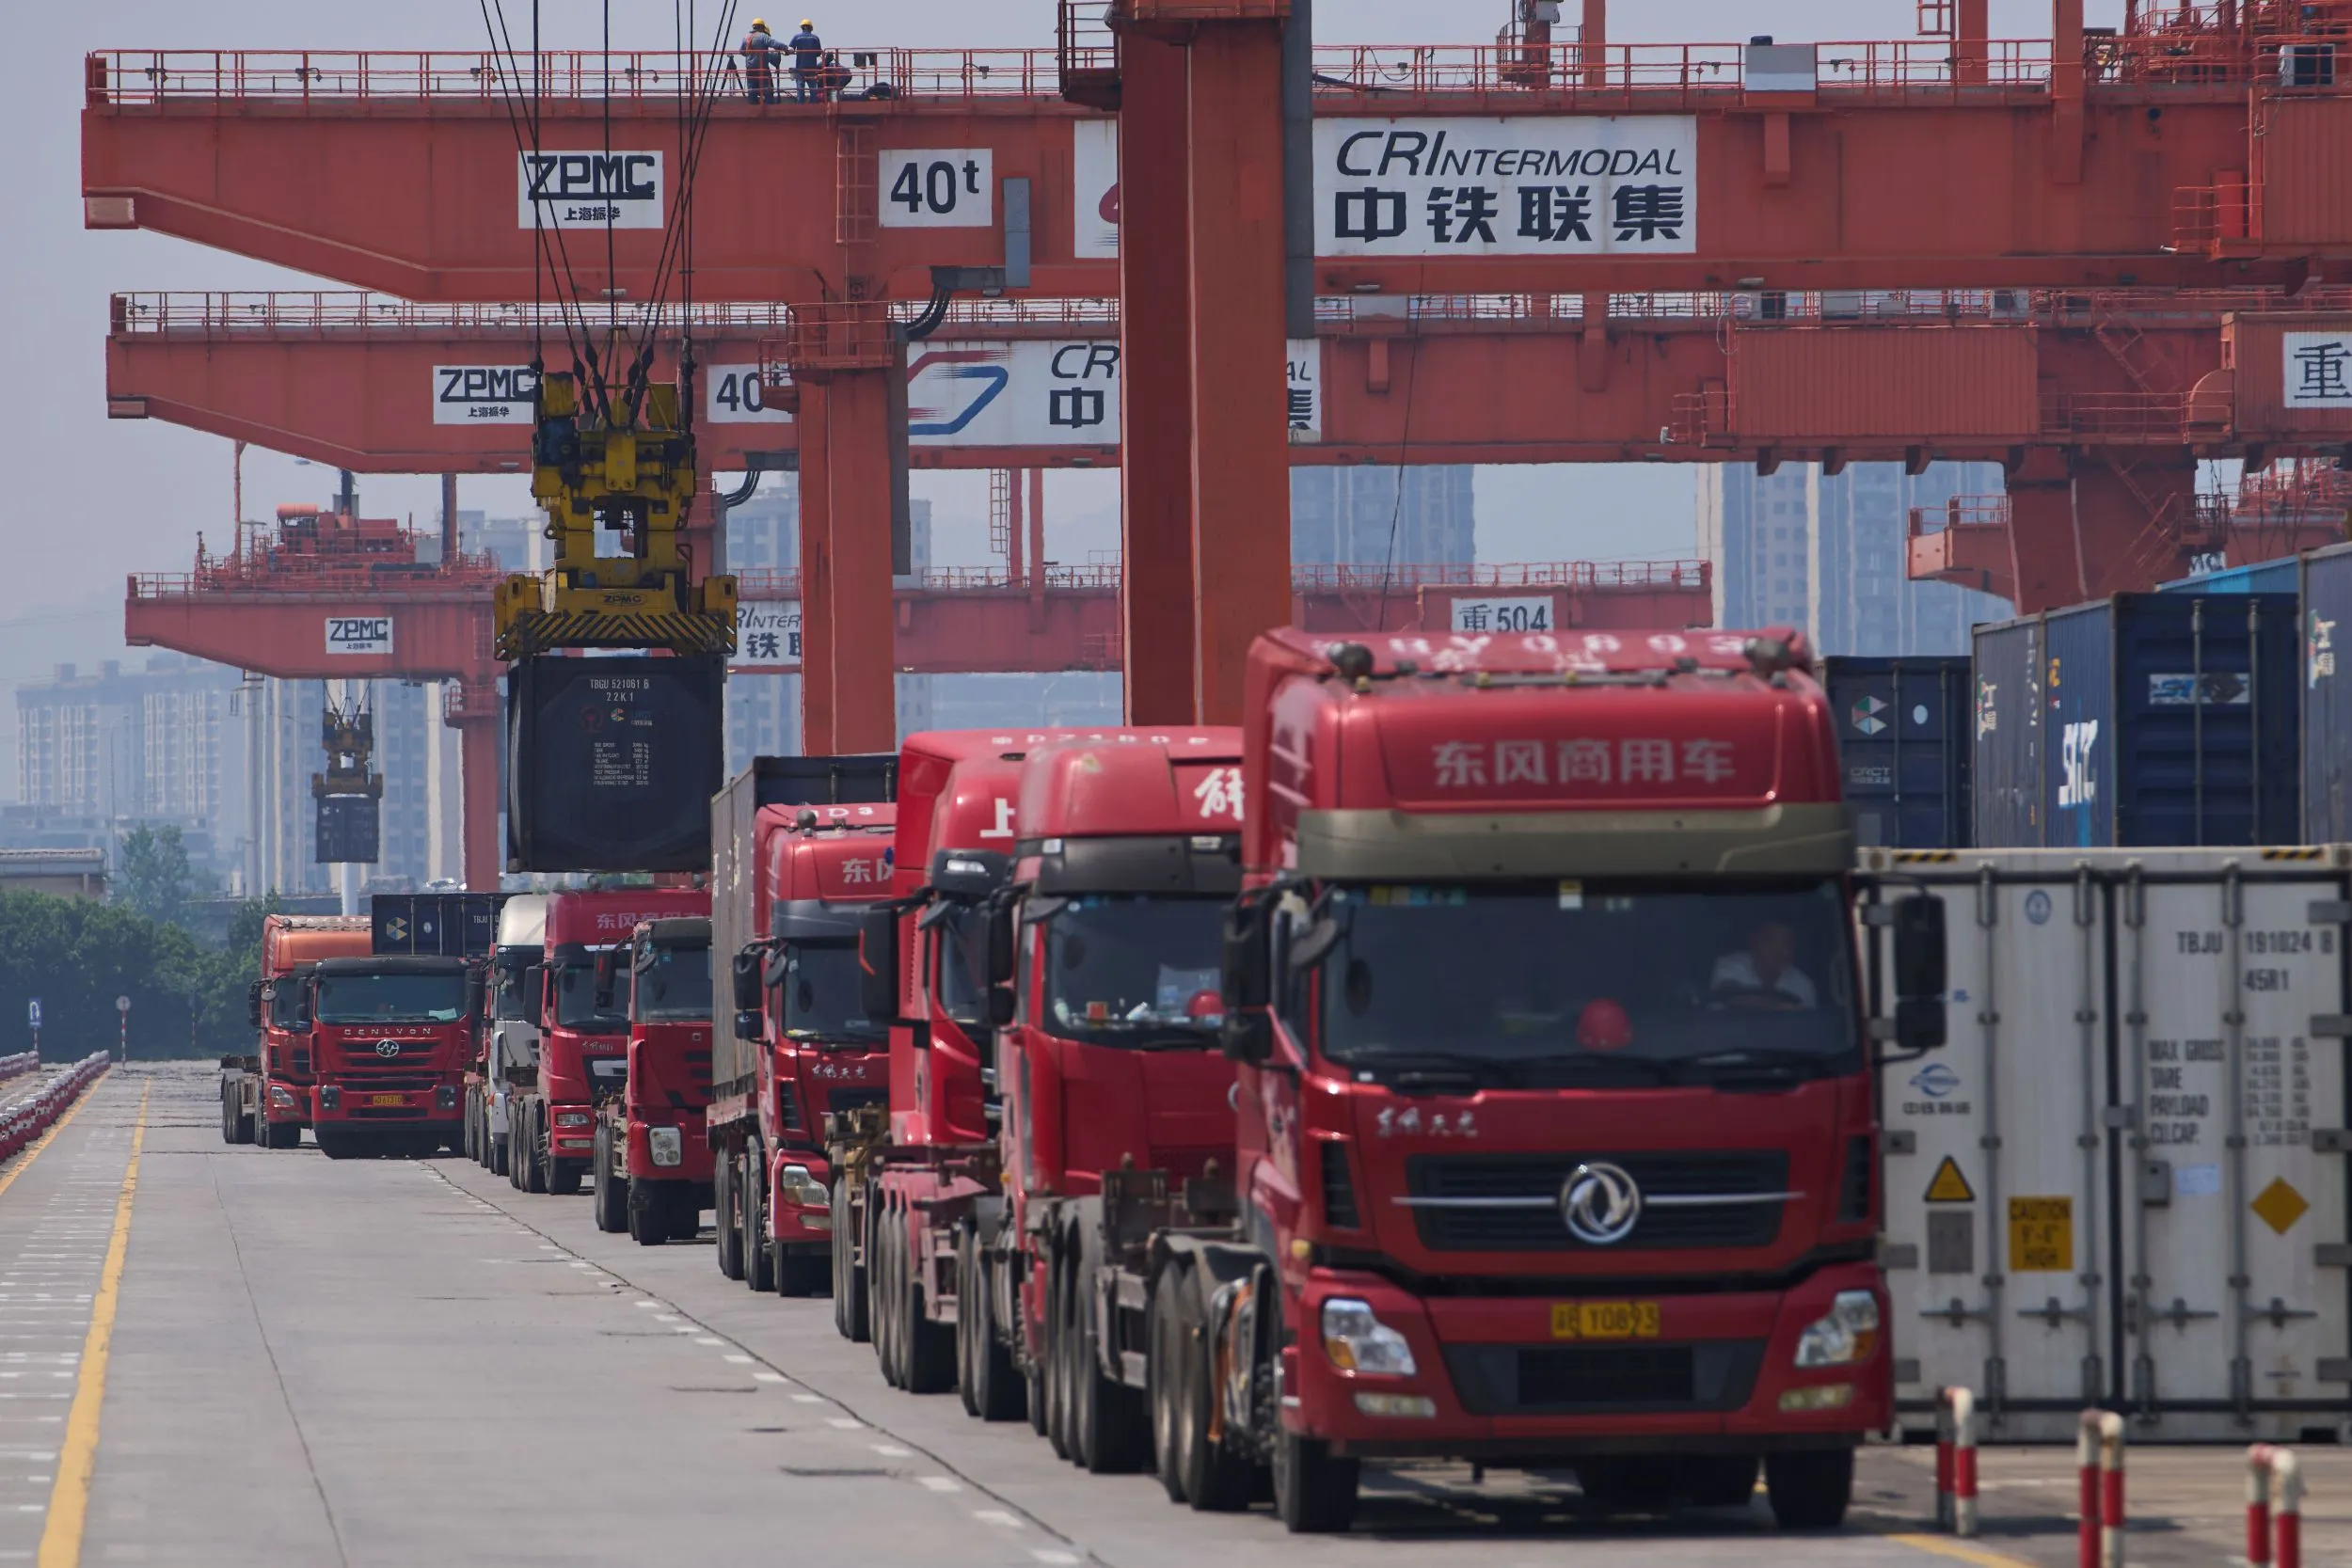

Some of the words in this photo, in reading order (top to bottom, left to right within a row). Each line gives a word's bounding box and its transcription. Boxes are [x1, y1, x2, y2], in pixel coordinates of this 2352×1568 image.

[527, 155, 656, 200] ZPMC
[564, 207, 621, 221] 上海振华
[1334, 186, 1684, 243] 中铁联集
[439, 369, 537, 403] ZPMC
[2294, 341, 2352, 400] 重
[329, 620, 389, 641] ZPMC
[612, 679, 641, 689] 521061
[1432, 737, 1737, 785] 东风商用车
